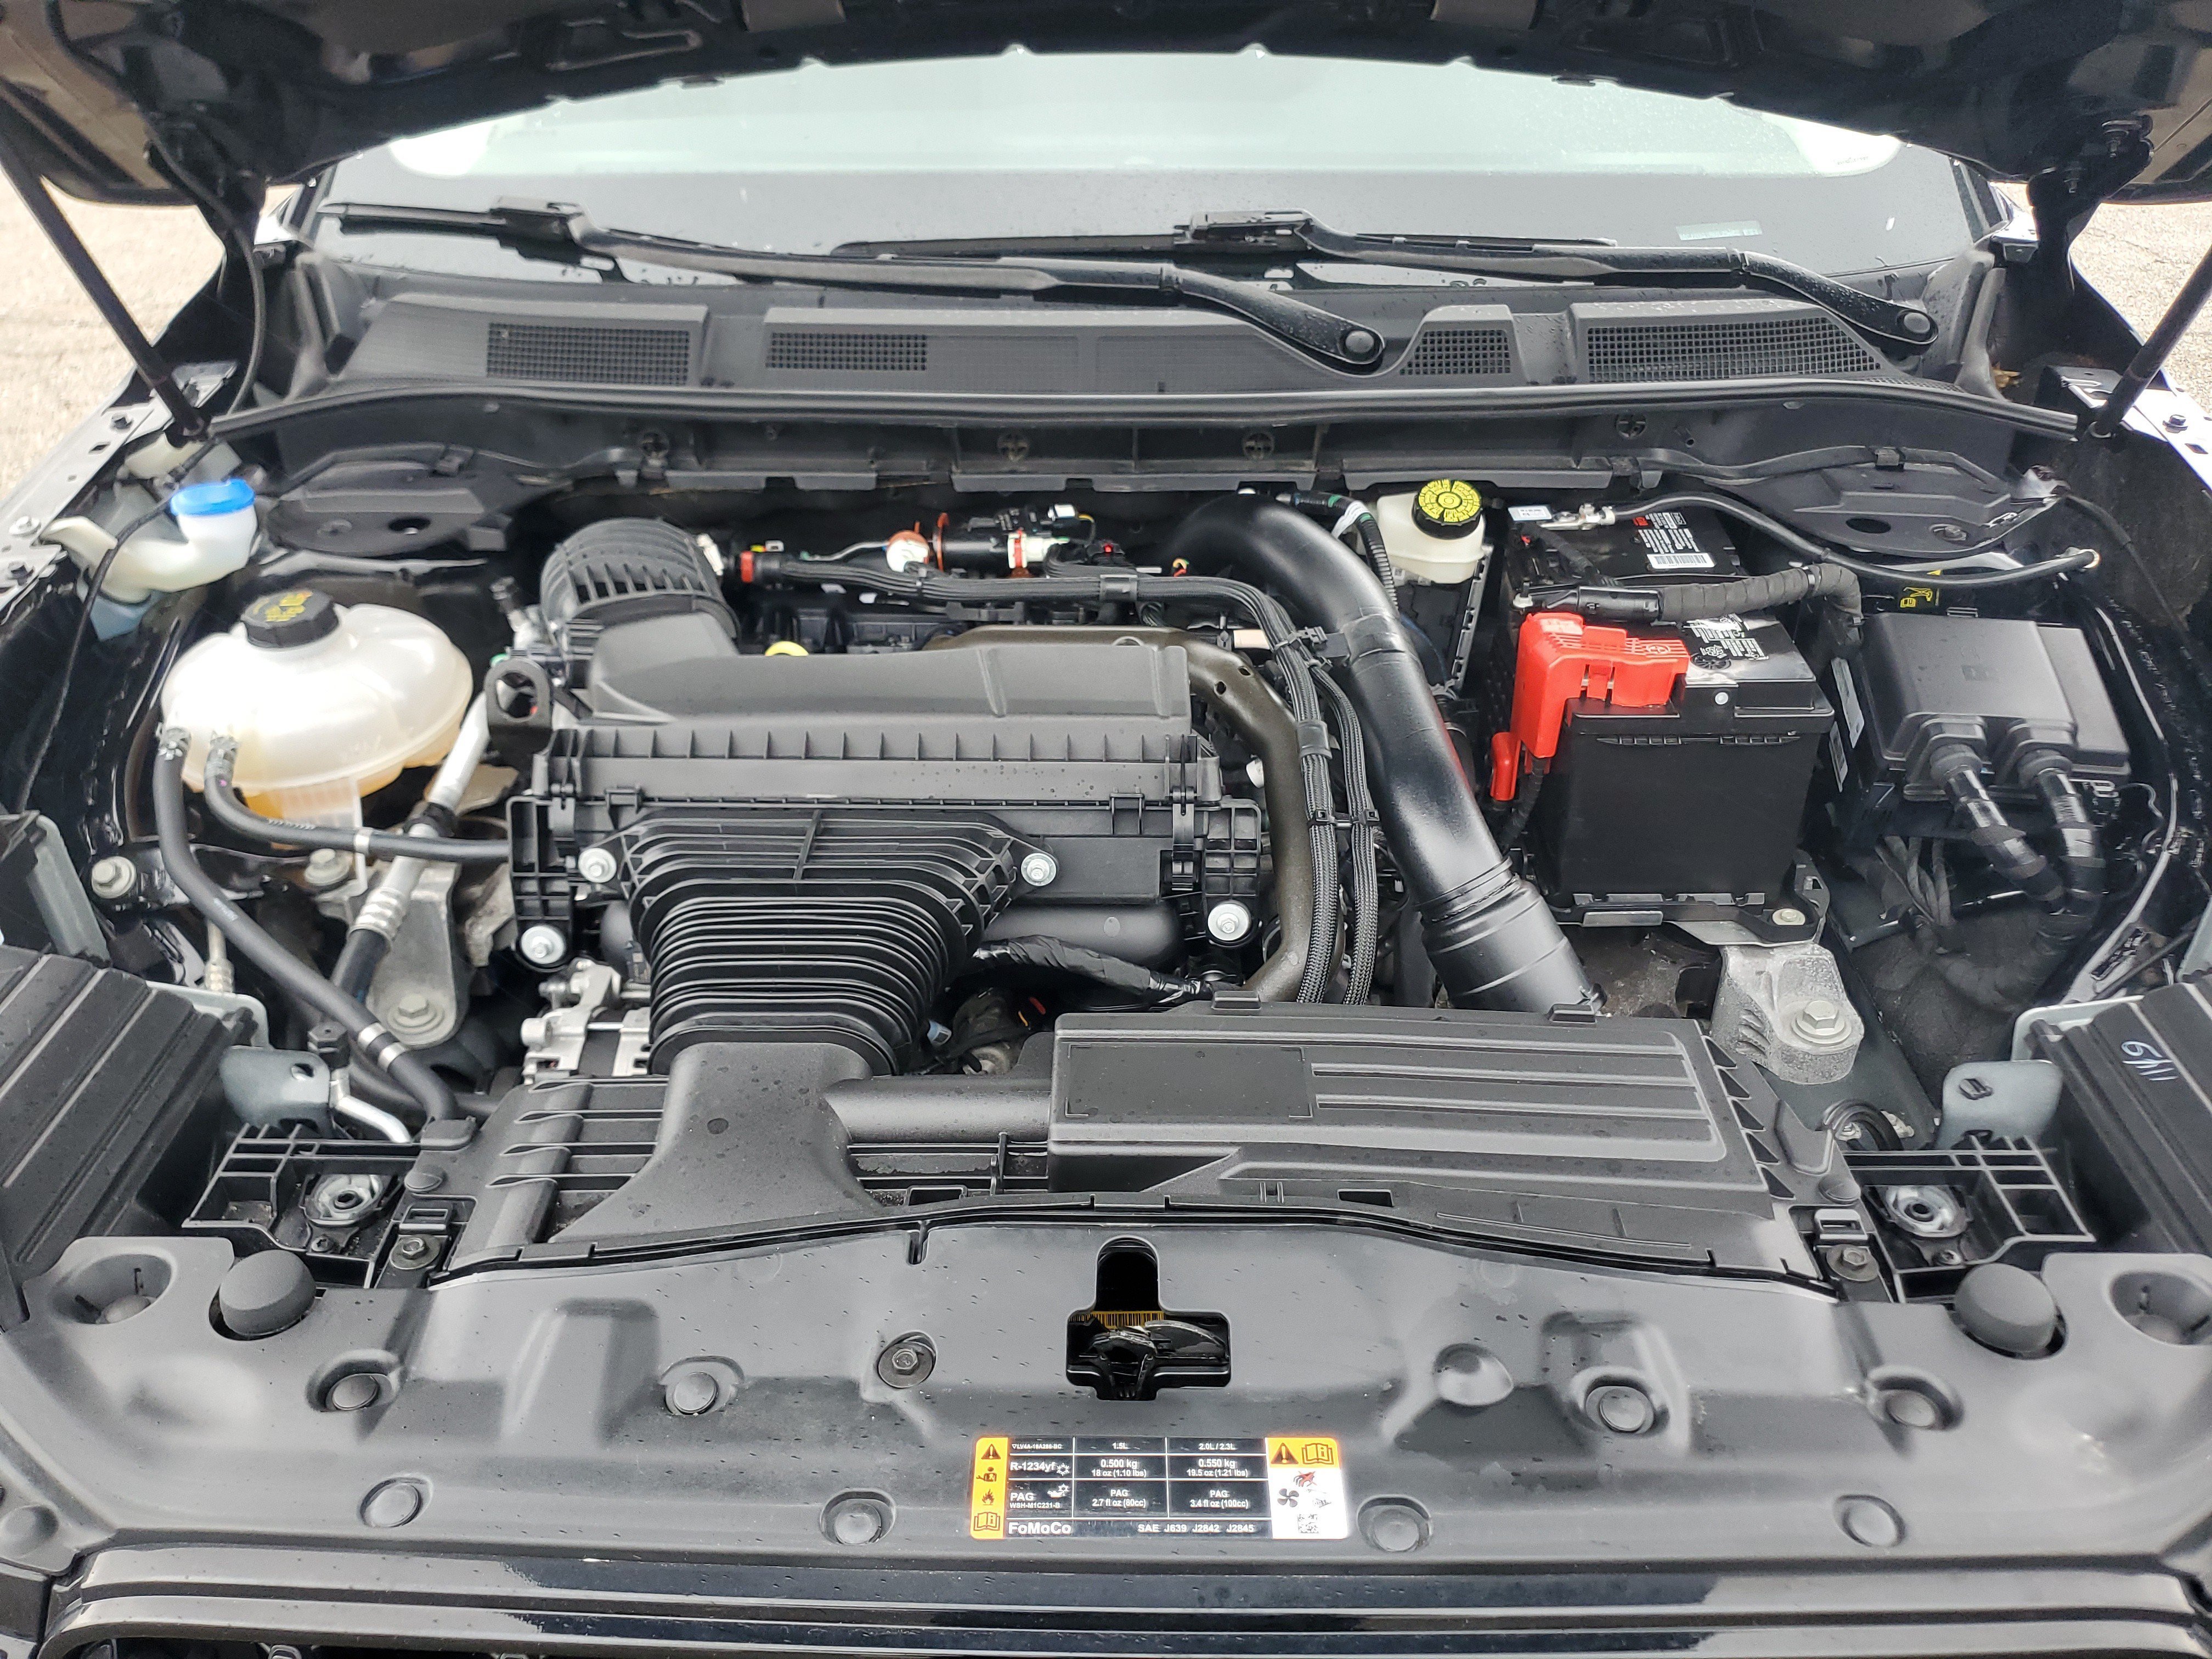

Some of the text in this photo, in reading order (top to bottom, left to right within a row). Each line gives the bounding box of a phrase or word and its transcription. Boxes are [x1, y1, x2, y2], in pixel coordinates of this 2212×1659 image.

[1010, 1461, 1056, 1472] R-1234yf
[1101, 1459, 1137, 1469] 0.500 kg
[1198, 1459, 1235, 1469] 0.550 kg
[1113, 1469, 1131, 1477] (1.10
[1133, 1469, 1147, 1477] lbs)
[1215, 1469, 1232, 1477] (1.21
[1234, 1469, 1248, 1477] lbs)
[1011, 1492, 1034, 1501] PAG
[1092, 1498, 1103, 1506] 2.7
[1105, 1498, 1110, 1506] fl
[1124, 1498, 1146, 1508] (80cc)
[1221, 1499, 1249, 1509] (100cc)
[1008, 1521, 1071, 1534] FoMoCo
[1138, 1523, 1255, 1532] SAE J639 J2842 J2845
